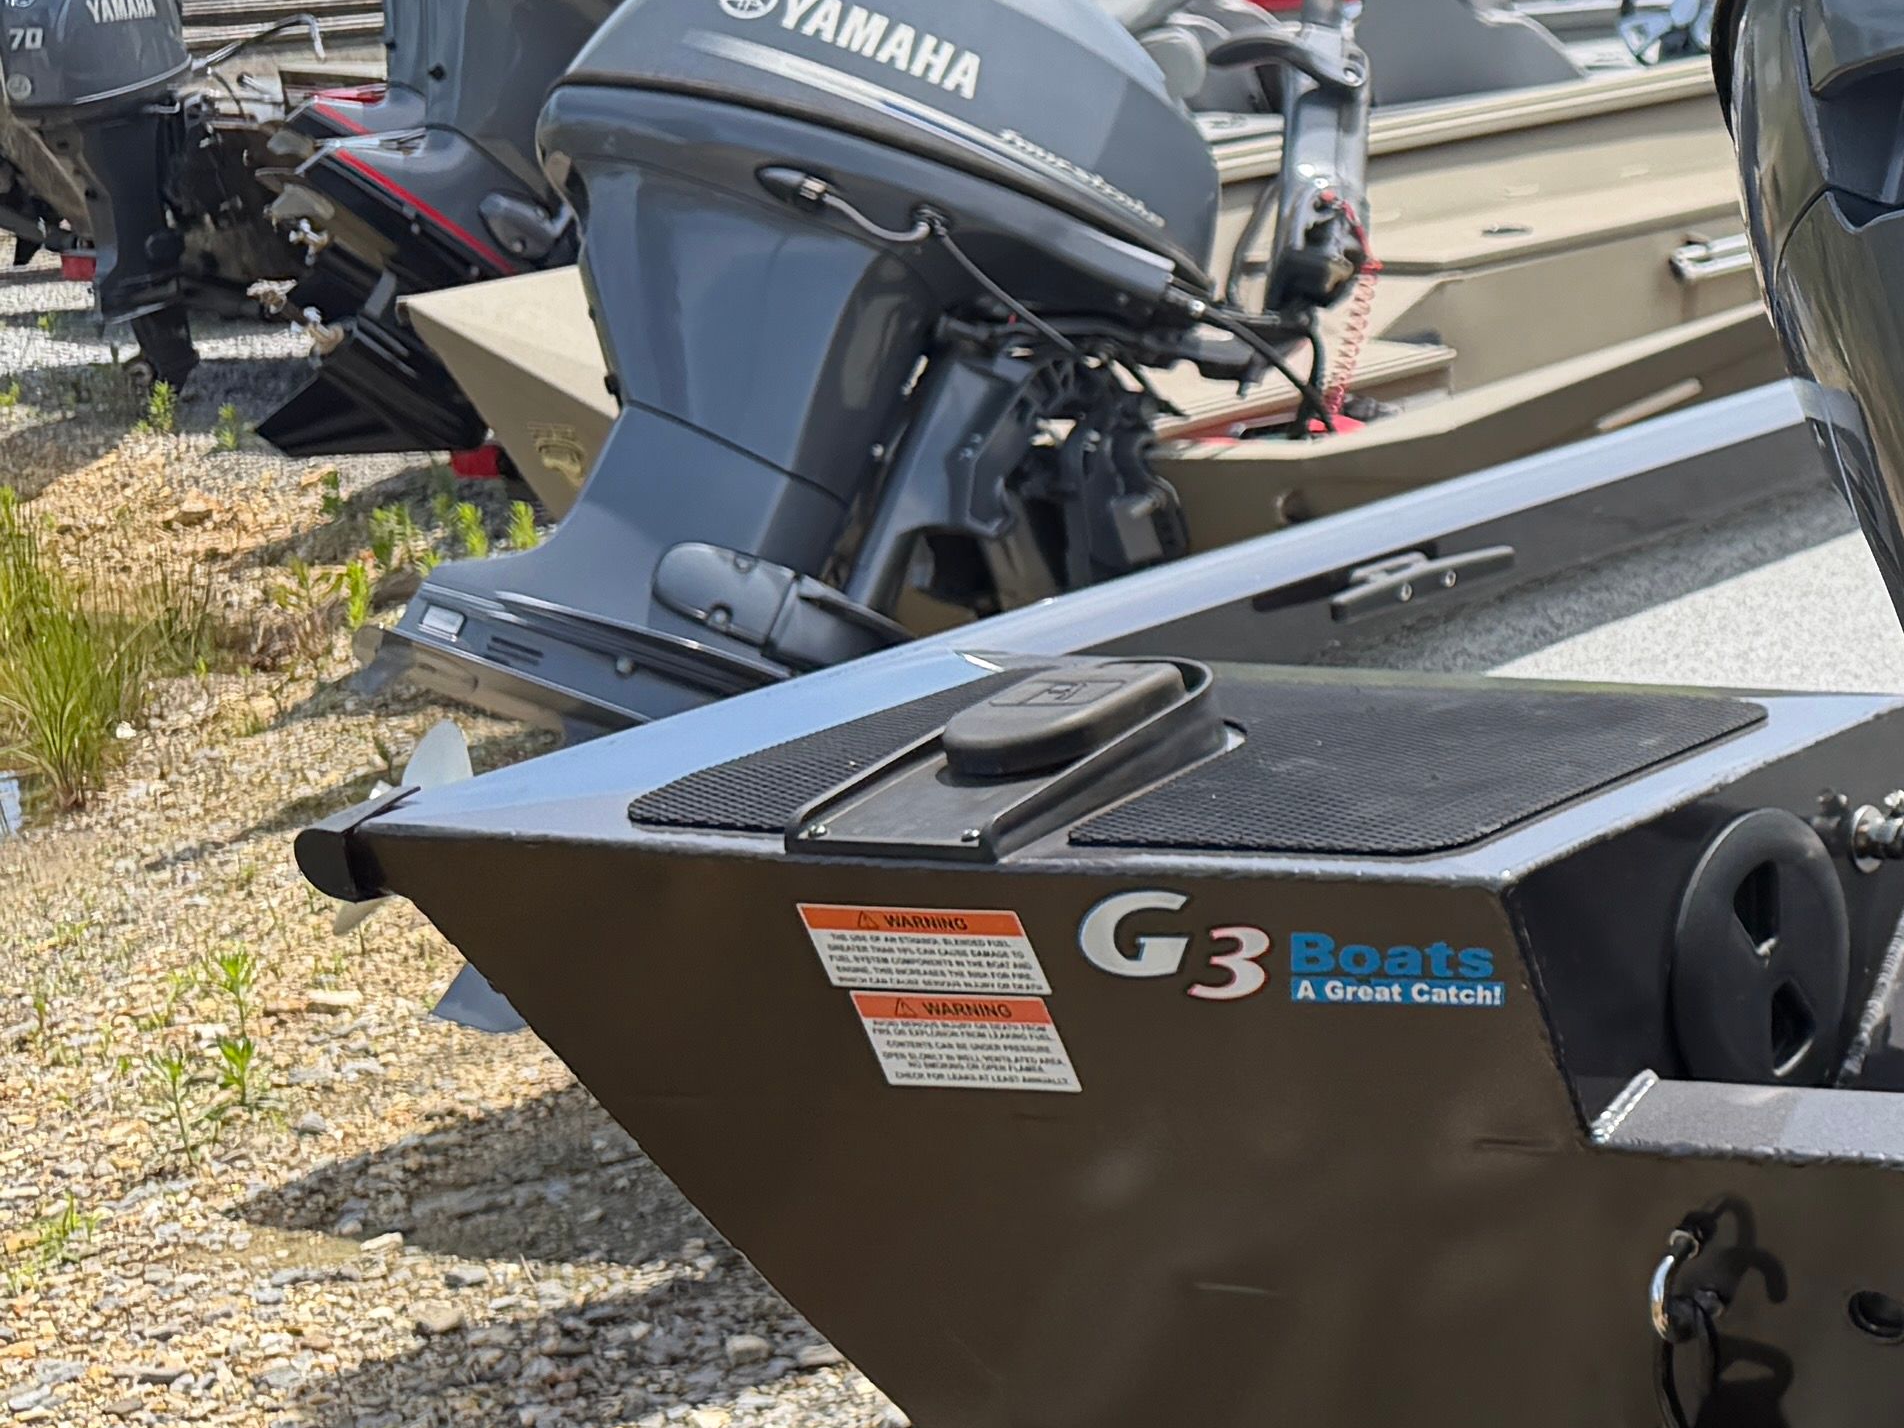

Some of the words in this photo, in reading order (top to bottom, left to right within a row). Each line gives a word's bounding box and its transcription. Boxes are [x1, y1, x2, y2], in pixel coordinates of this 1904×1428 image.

[9, 27, 44, 50] 70
[884, 914, 968, 931] WARNING
[1079, 888, 1271, 1000] G3
[1290, 932, 1495, 978] Boats
[1296, 980, 1316, 999] A
[1323, 979, 1407, 1002] Great
[1411, 982, 1502, 1006] Catch!
[922, 1002, 1012, 1018] WARNING
